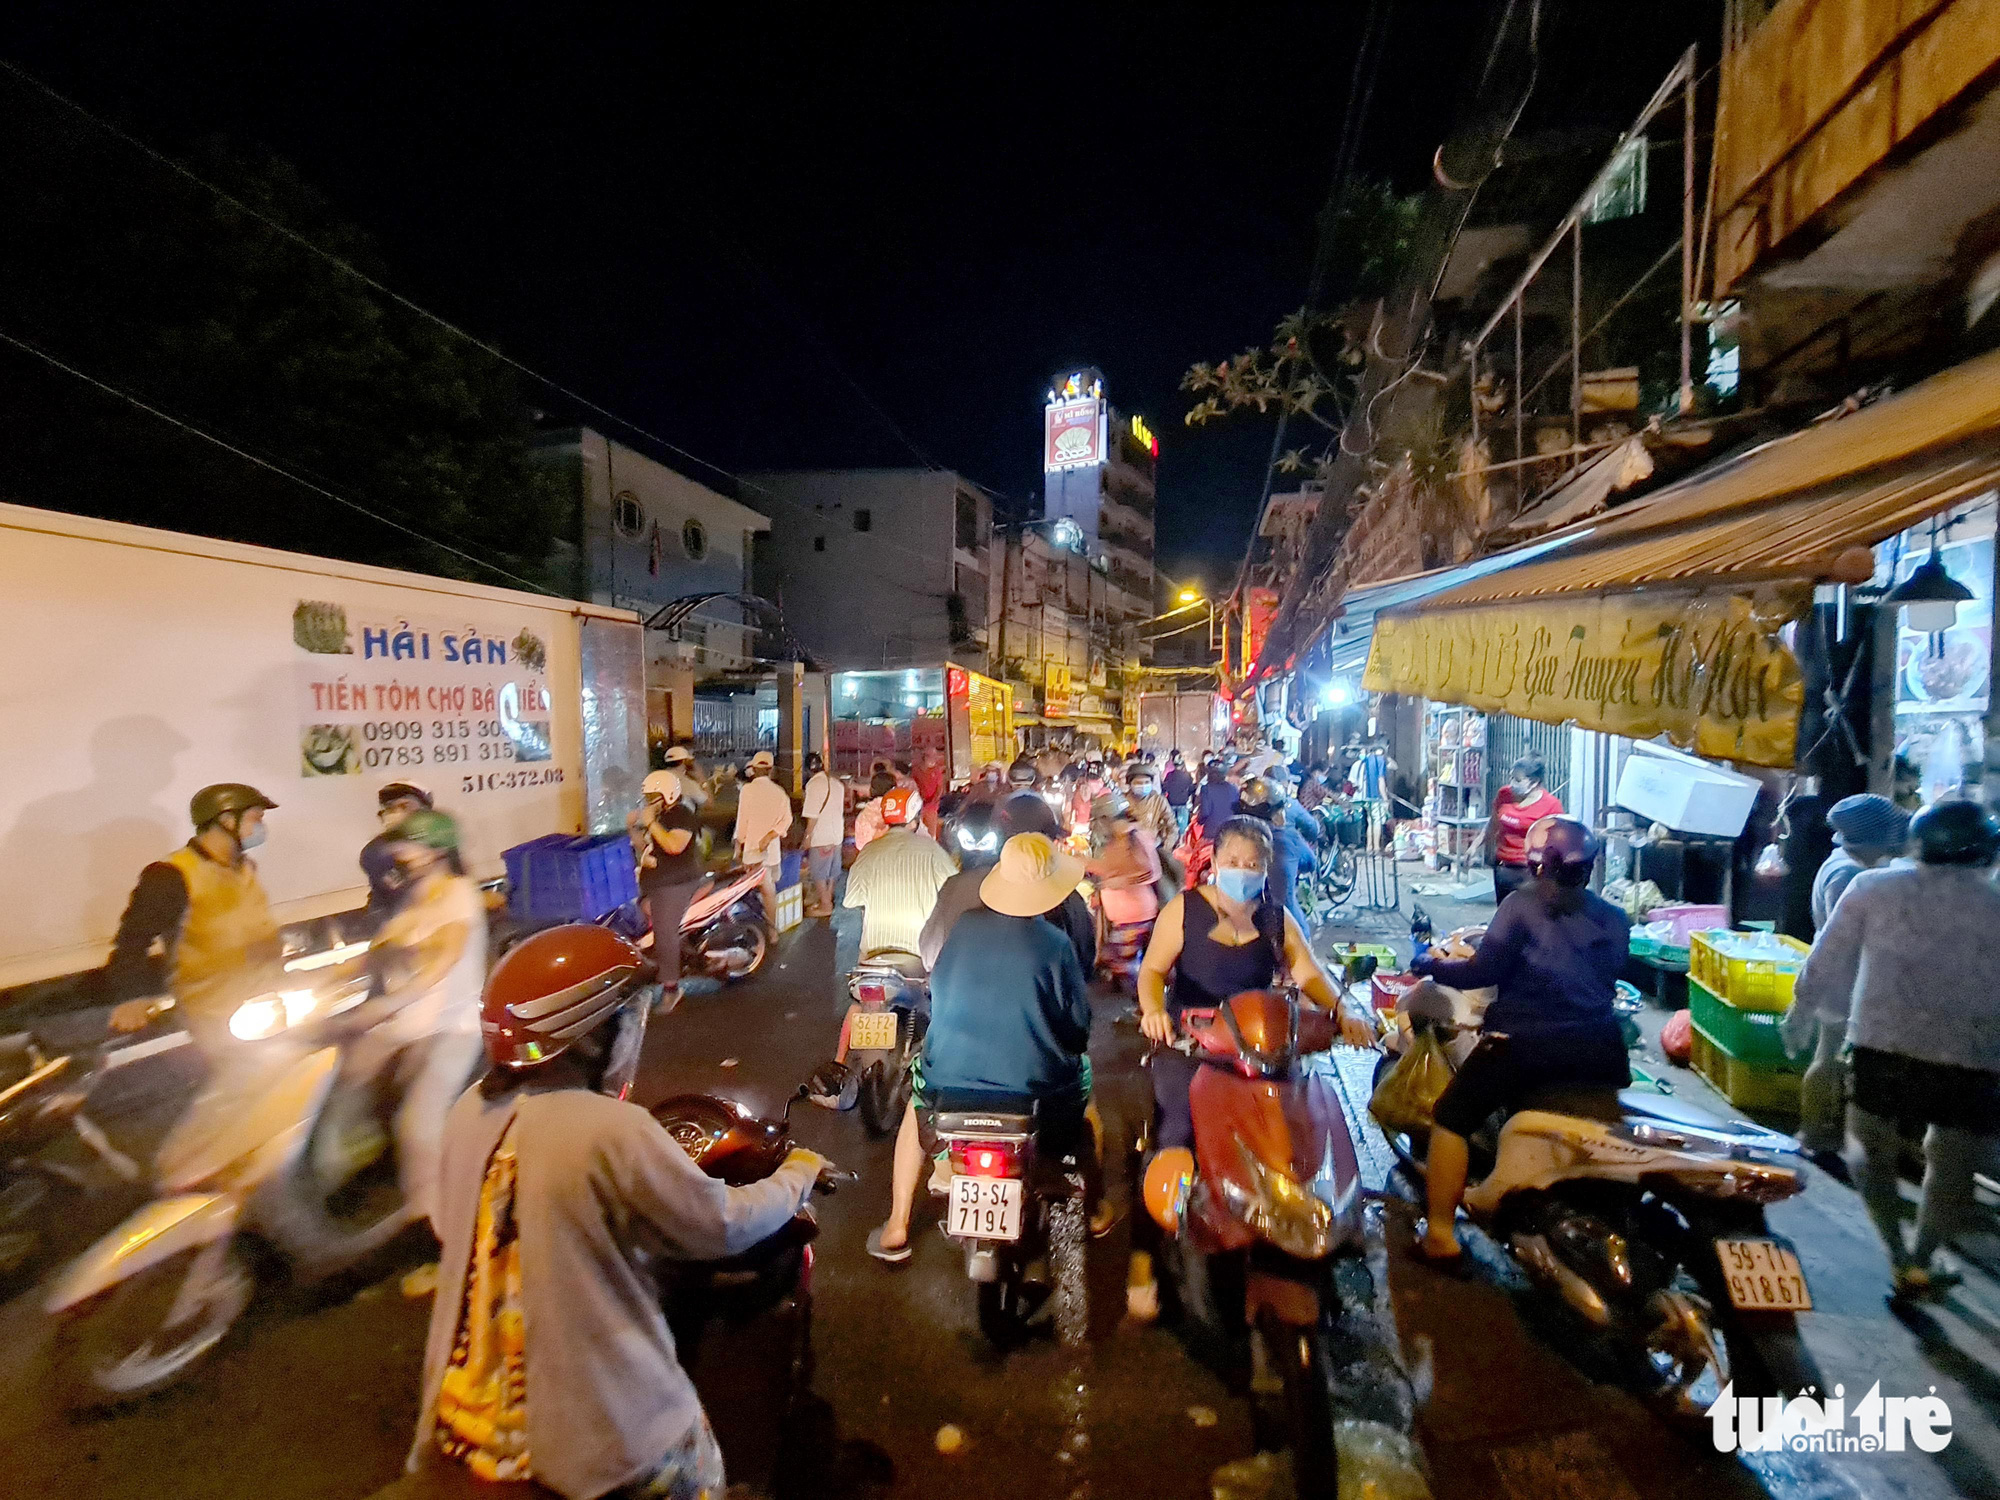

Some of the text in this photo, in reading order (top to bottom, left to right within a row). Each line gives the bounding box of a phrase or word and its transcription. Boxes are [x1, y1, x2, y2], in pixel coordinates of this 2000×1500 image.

[363, 621, 506, 665] HẢI SẢN
[310, 674, 367, 711] TIẾN
[374, 679, 420, 711] TÔM
[427, 684, 466, 716] CHỢ
[472, 682, 496, 712] BÀ
[363, 719, 509, 741] 0909 315 30
[365, 742, 514, 767] 0783 891 315
[963, 1119, 1003, 1127] HONDA
[961, 1181, 1009, 1206] 53-S4
[959, 1208, 1008, 1233] 7194
[1731, 1275, 1802, 1304] 91867
